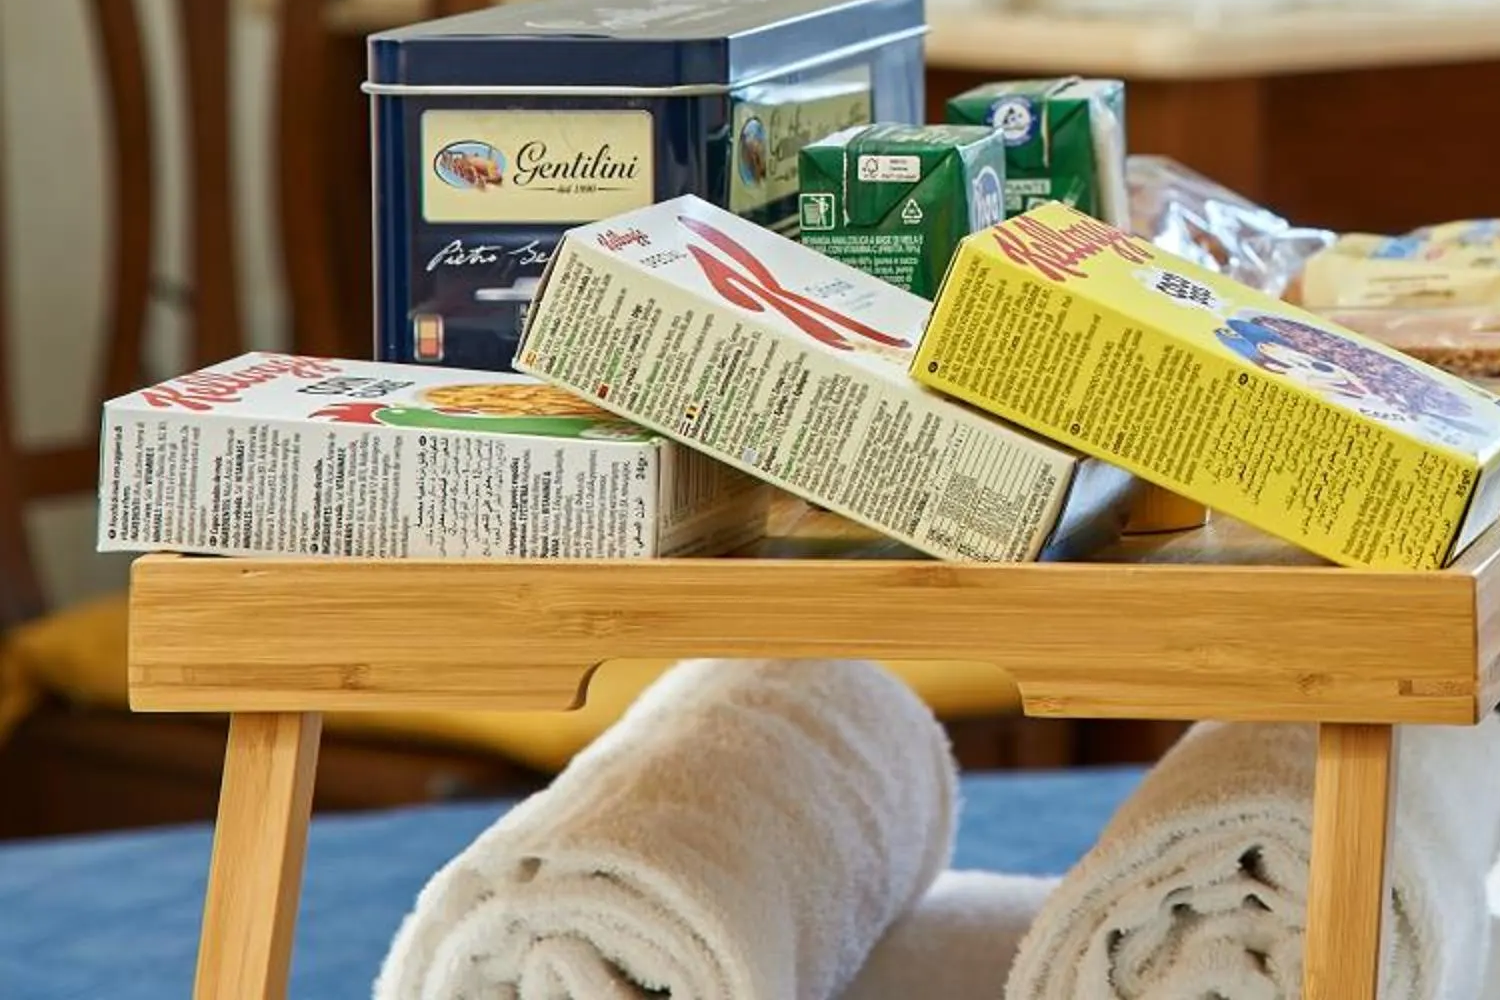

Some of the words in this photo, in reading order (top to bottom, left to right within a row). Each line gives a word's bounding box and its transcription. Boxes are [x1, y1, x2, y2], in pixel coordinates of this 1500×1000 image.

[513, 140, 640, 187] Gentilini
[992, 215, 1154, 283] Kellogg's
[141, 351, 342, 410] Kellogg's
